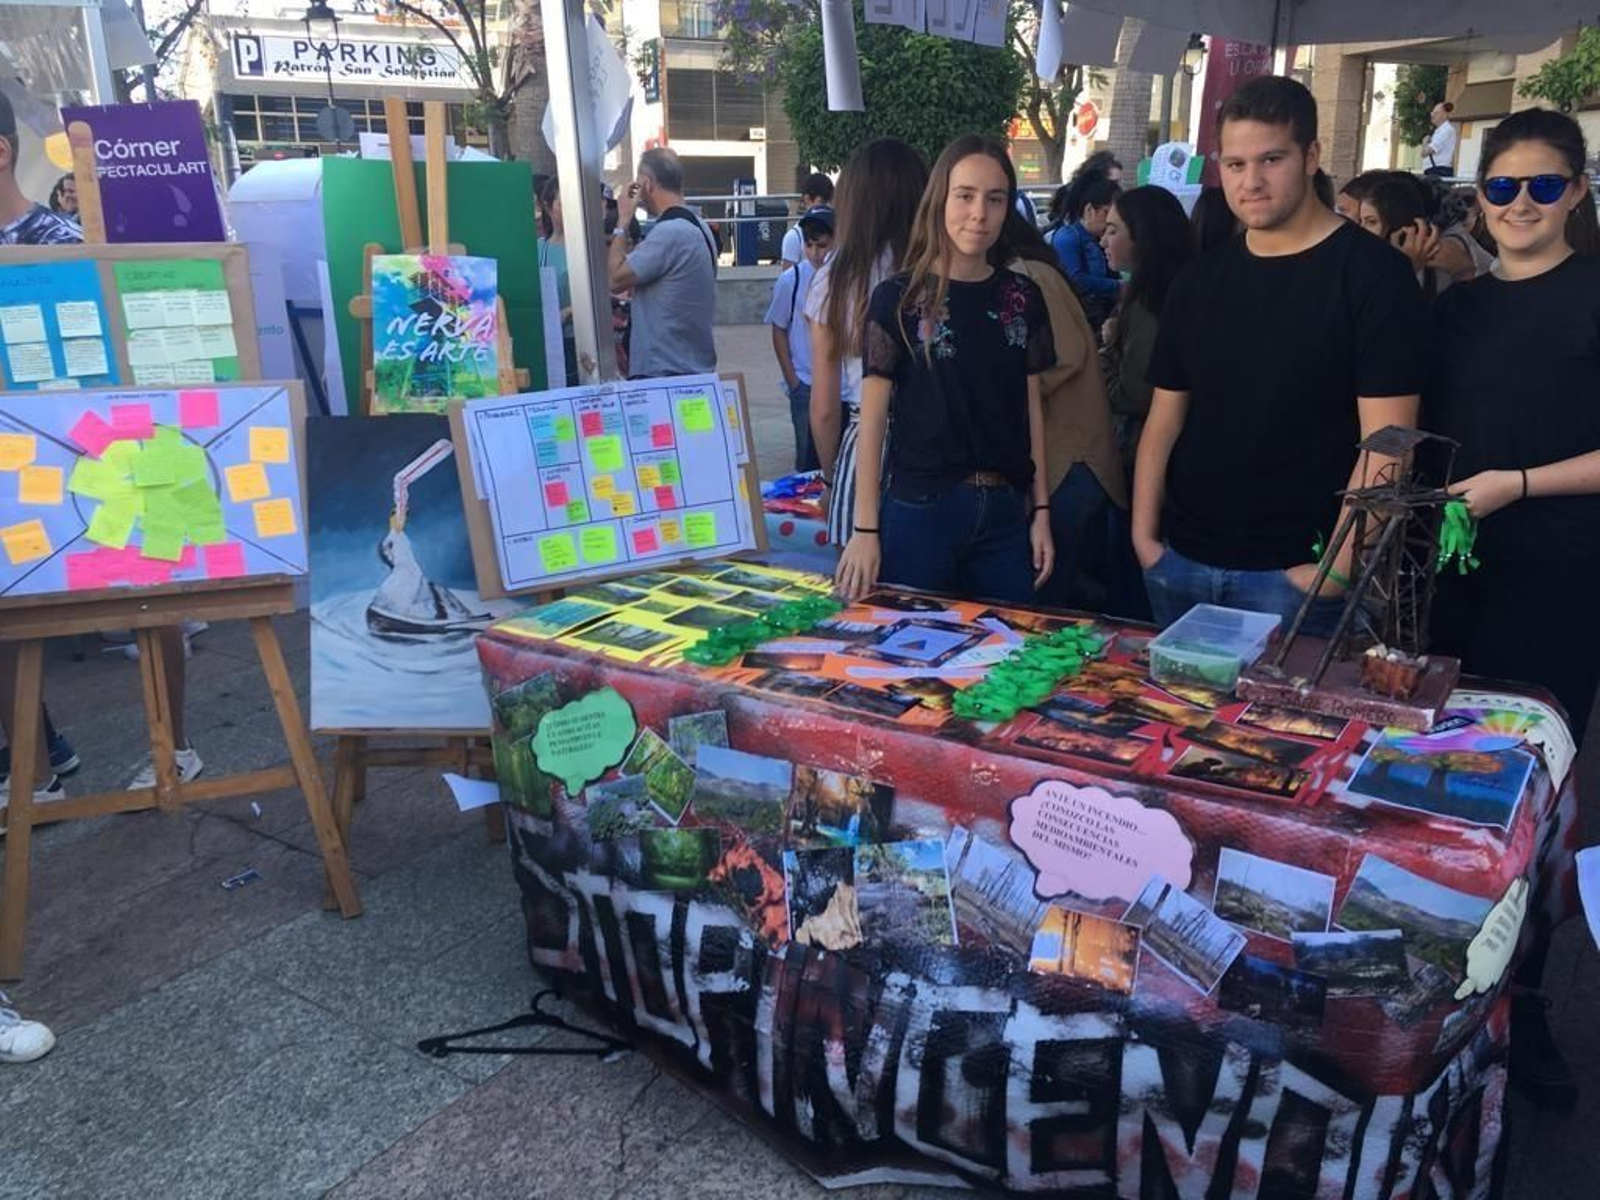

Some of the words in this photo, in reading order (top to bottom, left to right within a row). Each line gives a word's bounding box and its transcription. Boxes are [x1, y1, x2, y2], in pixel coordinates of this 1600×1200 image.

[294, 41, 437, 66] PARKING
[338, 63, 373, 77] San
[94, 138, 181, 160] Córner
[95, 161, 207, 179] PECTACULART
[386, 311, 495, 338] NERVA
[381, 339, 417, 361] ES
[419, 341, 488, 362] ARTE
[1046, 789, 1068, 802] ANTE
[1072, 799, 1086, 811] UN
[1031, 830, 1049, 842] DEL
[1037, 810, 1120, 848] CONSECUENCIAS
[1095, 820, 1115, 834] LAS
[1036, 820, 1138, 868] MEDIOAMBIENTALES
